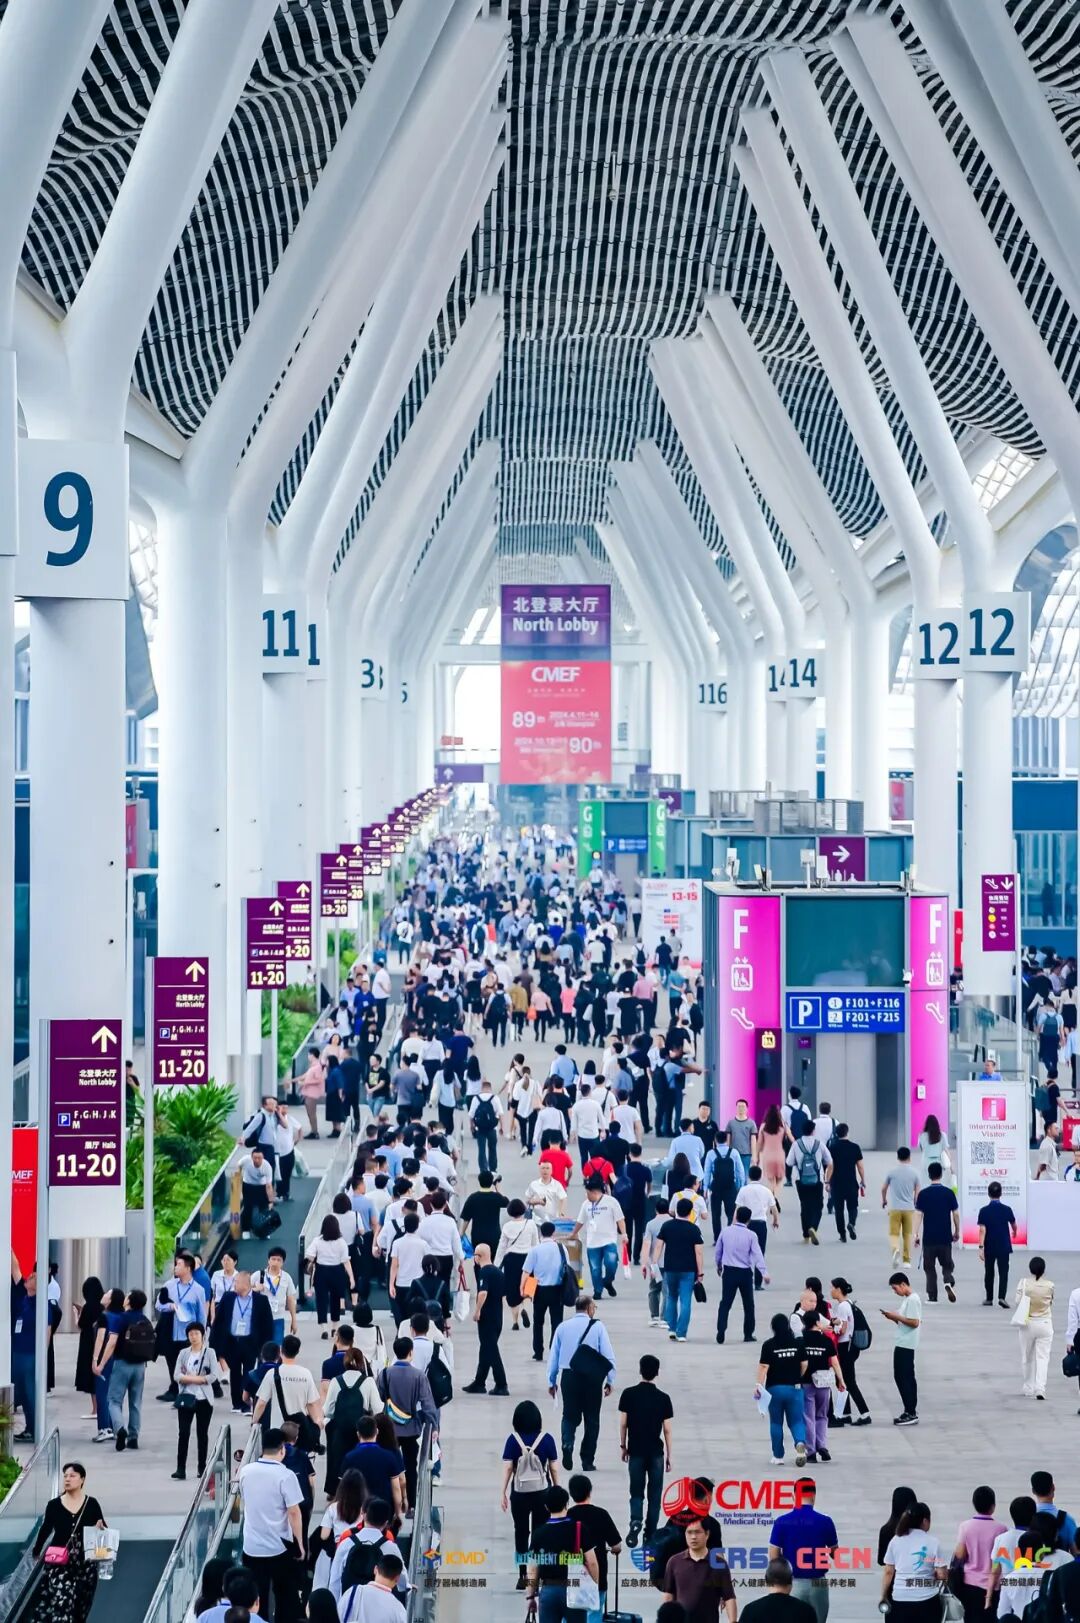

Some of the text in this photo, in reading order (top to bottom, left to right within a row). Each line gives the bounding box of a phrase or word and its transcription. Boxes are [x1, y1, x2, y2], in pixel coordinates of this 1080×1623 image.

[43, 471, 94, 567] 9
[513, 597, 600, 613] 北登录大厅
[262, 609, 300, 657] 11
[512, 617, 599, 635] North Lobby
[969, 608, 1015, 656] 12
[919, 622, 960, 664] 12
[531, 667, 581, 682] CMEF
[789, 658, 817, 688] 14
[583, 806, 593, 822] G
[656, 804, 665, 821] G
[733, 909, 749, 949] F
[929, 904, 942, 944] F
[250, 971, 284, 985] 11-20
[798, 1000, 813, 1025] P
[159, 1059, 206, 1077] 11-20
[97, 1078, 117, 1087] Lobby
[72, 1121, 80, 1129] M
[57, 1153, 117, 1177] 11-20
